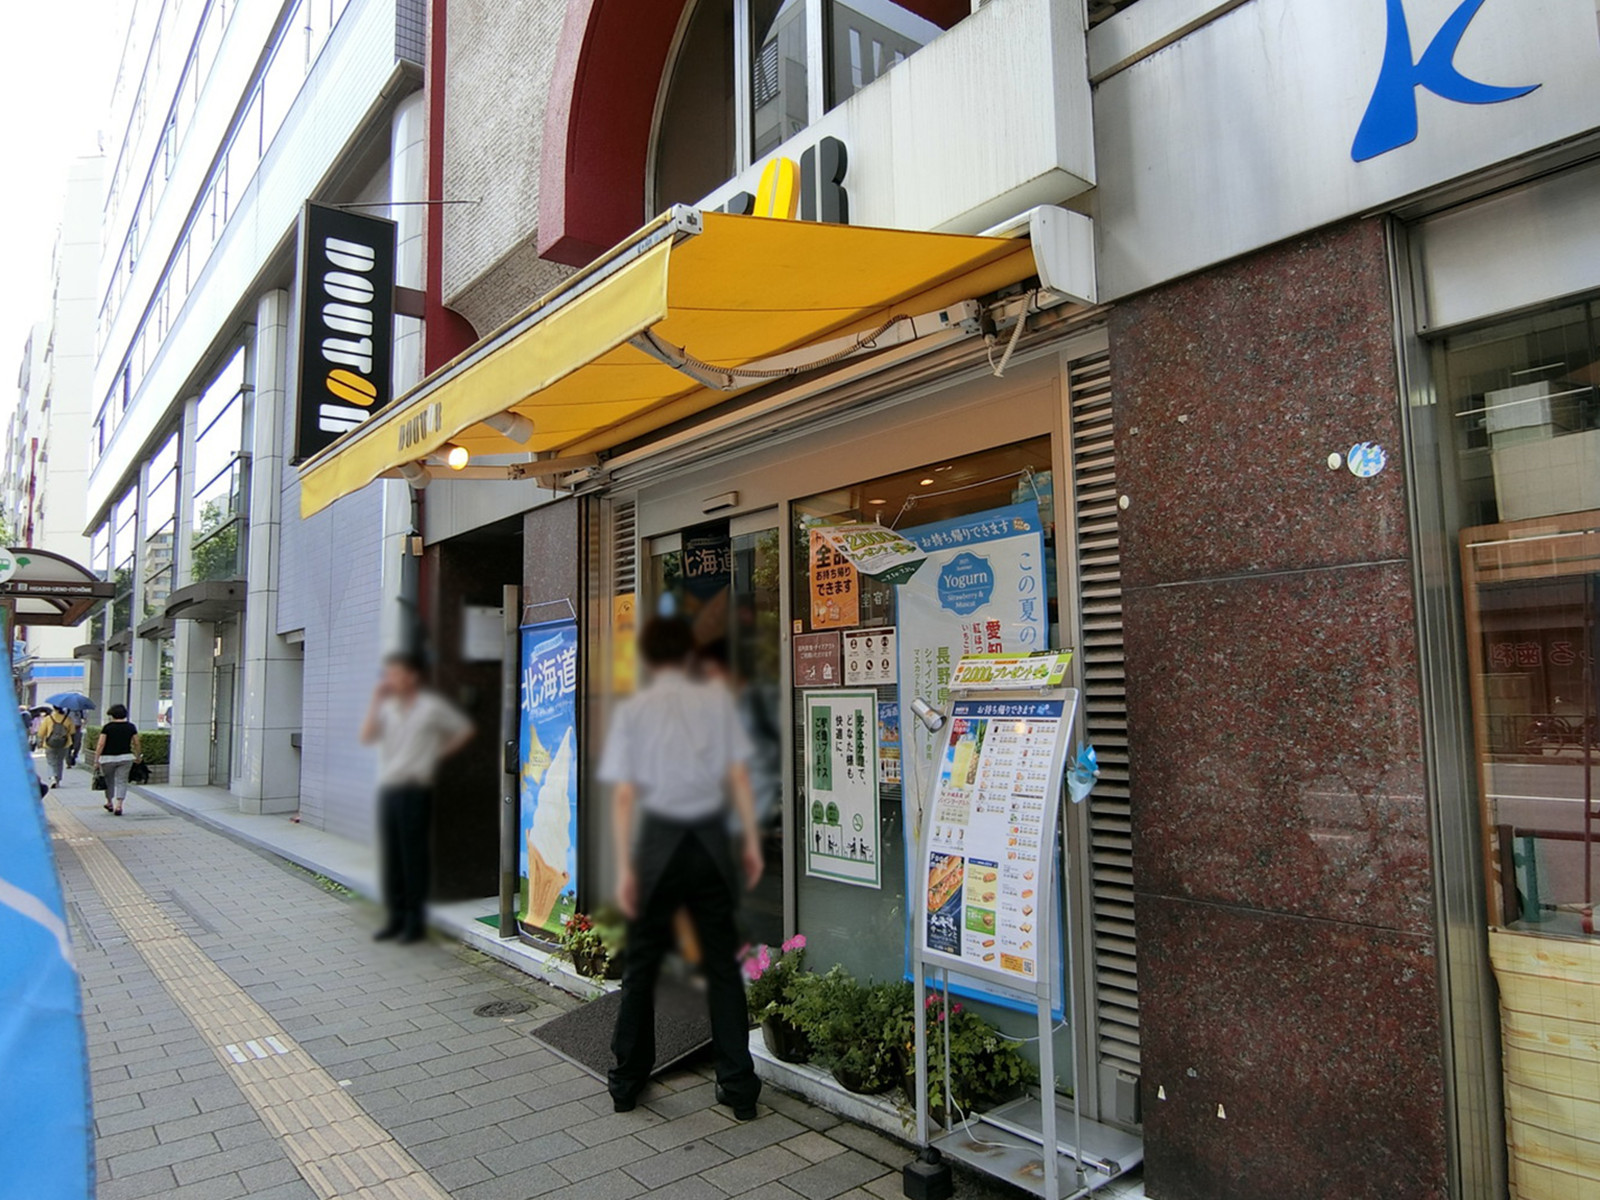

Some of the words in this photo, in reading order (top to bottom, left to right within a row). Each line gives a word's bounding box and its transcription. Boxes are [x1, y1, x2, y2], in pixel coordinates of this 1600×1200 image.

[1351, 0, 1543, 163] K
[713, 136, 849, 224] OR
[922, 520, 1009, 548] お持ち帰りできます
[816, 567, 851, 581] お持ち帰り
[816, 580, 852, 597] できます
[943, 572, 988, 589] Yogurn
[522, 646, 576, 712] 北海道
[936, 646, 951, 706] 長野県
